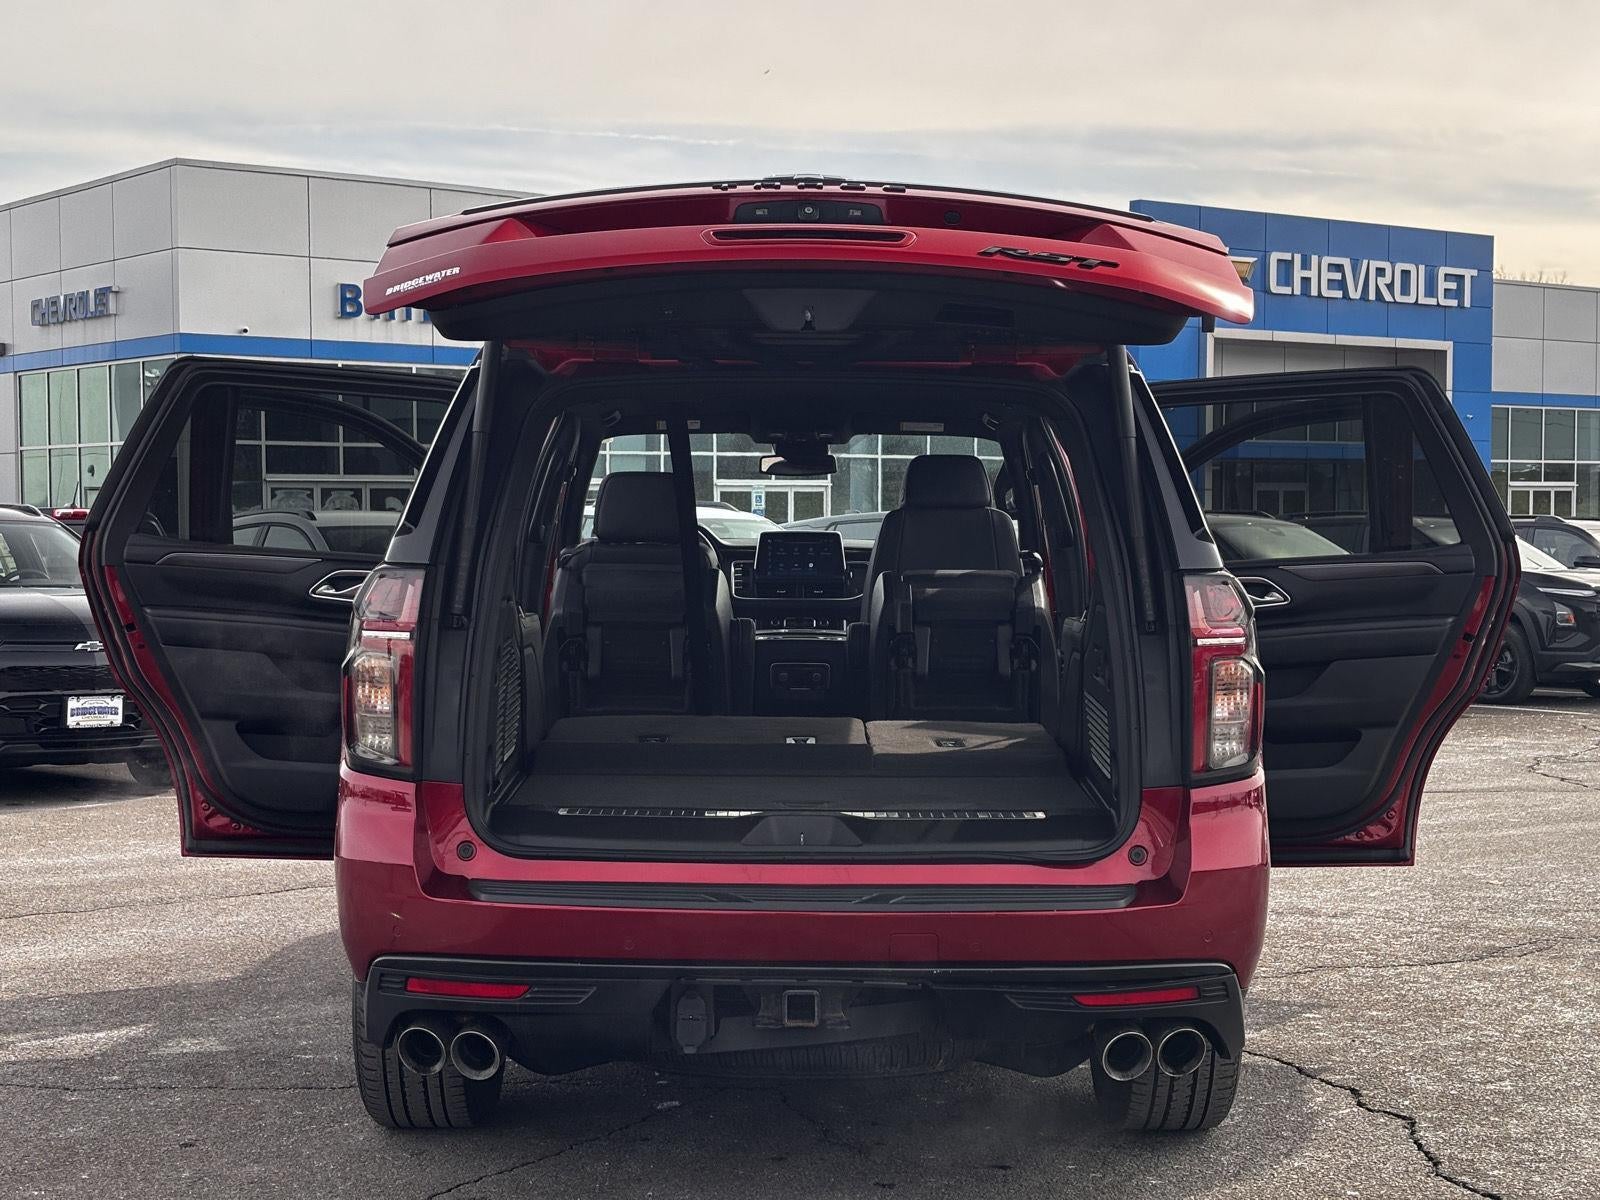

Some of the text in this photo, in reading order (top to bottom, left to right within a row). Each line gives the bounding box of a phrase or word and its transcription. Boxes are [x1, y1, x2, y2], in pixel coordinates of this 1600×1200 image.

[976, 245, 1120, 270] RST
[385, 266, 461, 296] BRIDGEWATER
[1269, 251, 1478, 308] CHEVROLET
[31, 286, 119, 327] CHEVROLET
